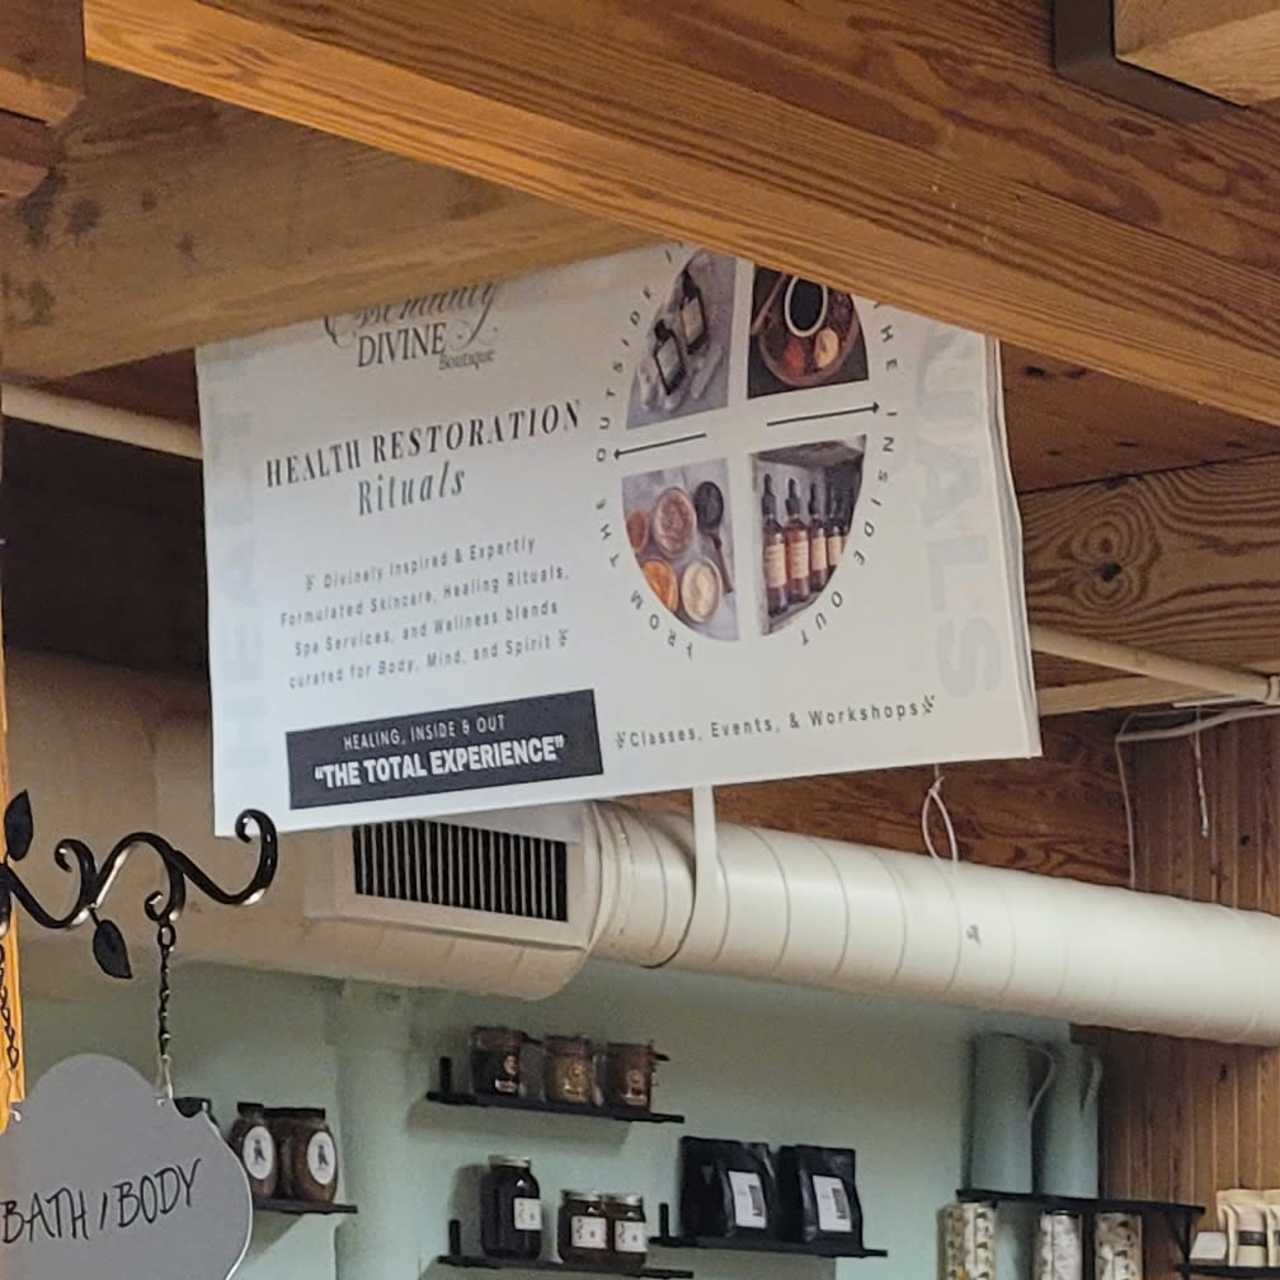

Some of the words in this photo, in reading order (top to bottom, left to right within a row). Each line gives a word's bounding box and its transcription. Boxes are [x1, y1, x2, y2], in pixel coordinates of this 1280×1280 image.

[356, 322, 447, 368] DIVINE
[265, 437, 362, 488] HEALTH
[372, 399, 581, 464] RESTORATION
[358, 461, 465, 516] Rituals
[323, 562, 384, 589] Divinely
[389, 551, 447, 577] Inspired
[469, 536, 536, 562] Expertly
[280, 598, 364, 629] Formulated
[443, 577, 500, 602] Healing
[506, 564, 570, 589] Rituals,
[294, 639, 320, 659] Spa
[325, 628, 394, 654] Services,
[403, 622, 428, 642] and
[434, 610, 499, 636] Wellness
[505, 599, 559, 623] blends
[288, 667, 343, 690] curated
[350, 660, 372, 680] for
[427, 646, 466, 669] Mind,
[473, 642, 499, 661] and
[505, 632, 552, 658] Spirit
[343, 728, 407, 751] HEALING,
[410, 719, 457, 742] INSIDE
[476, 714, 506, 732] OUT
[630, 727, 704, 749] Classes,
[709, 716, 781, 739] Events,
[788, 711, 801, 730] &
[807, 700, 919, 728] Workshops
[363, 752, 428, 783] TOTAL
[0, 1185, 89, 1244] BATH
[113, 1157, 203, 1229] BODY
